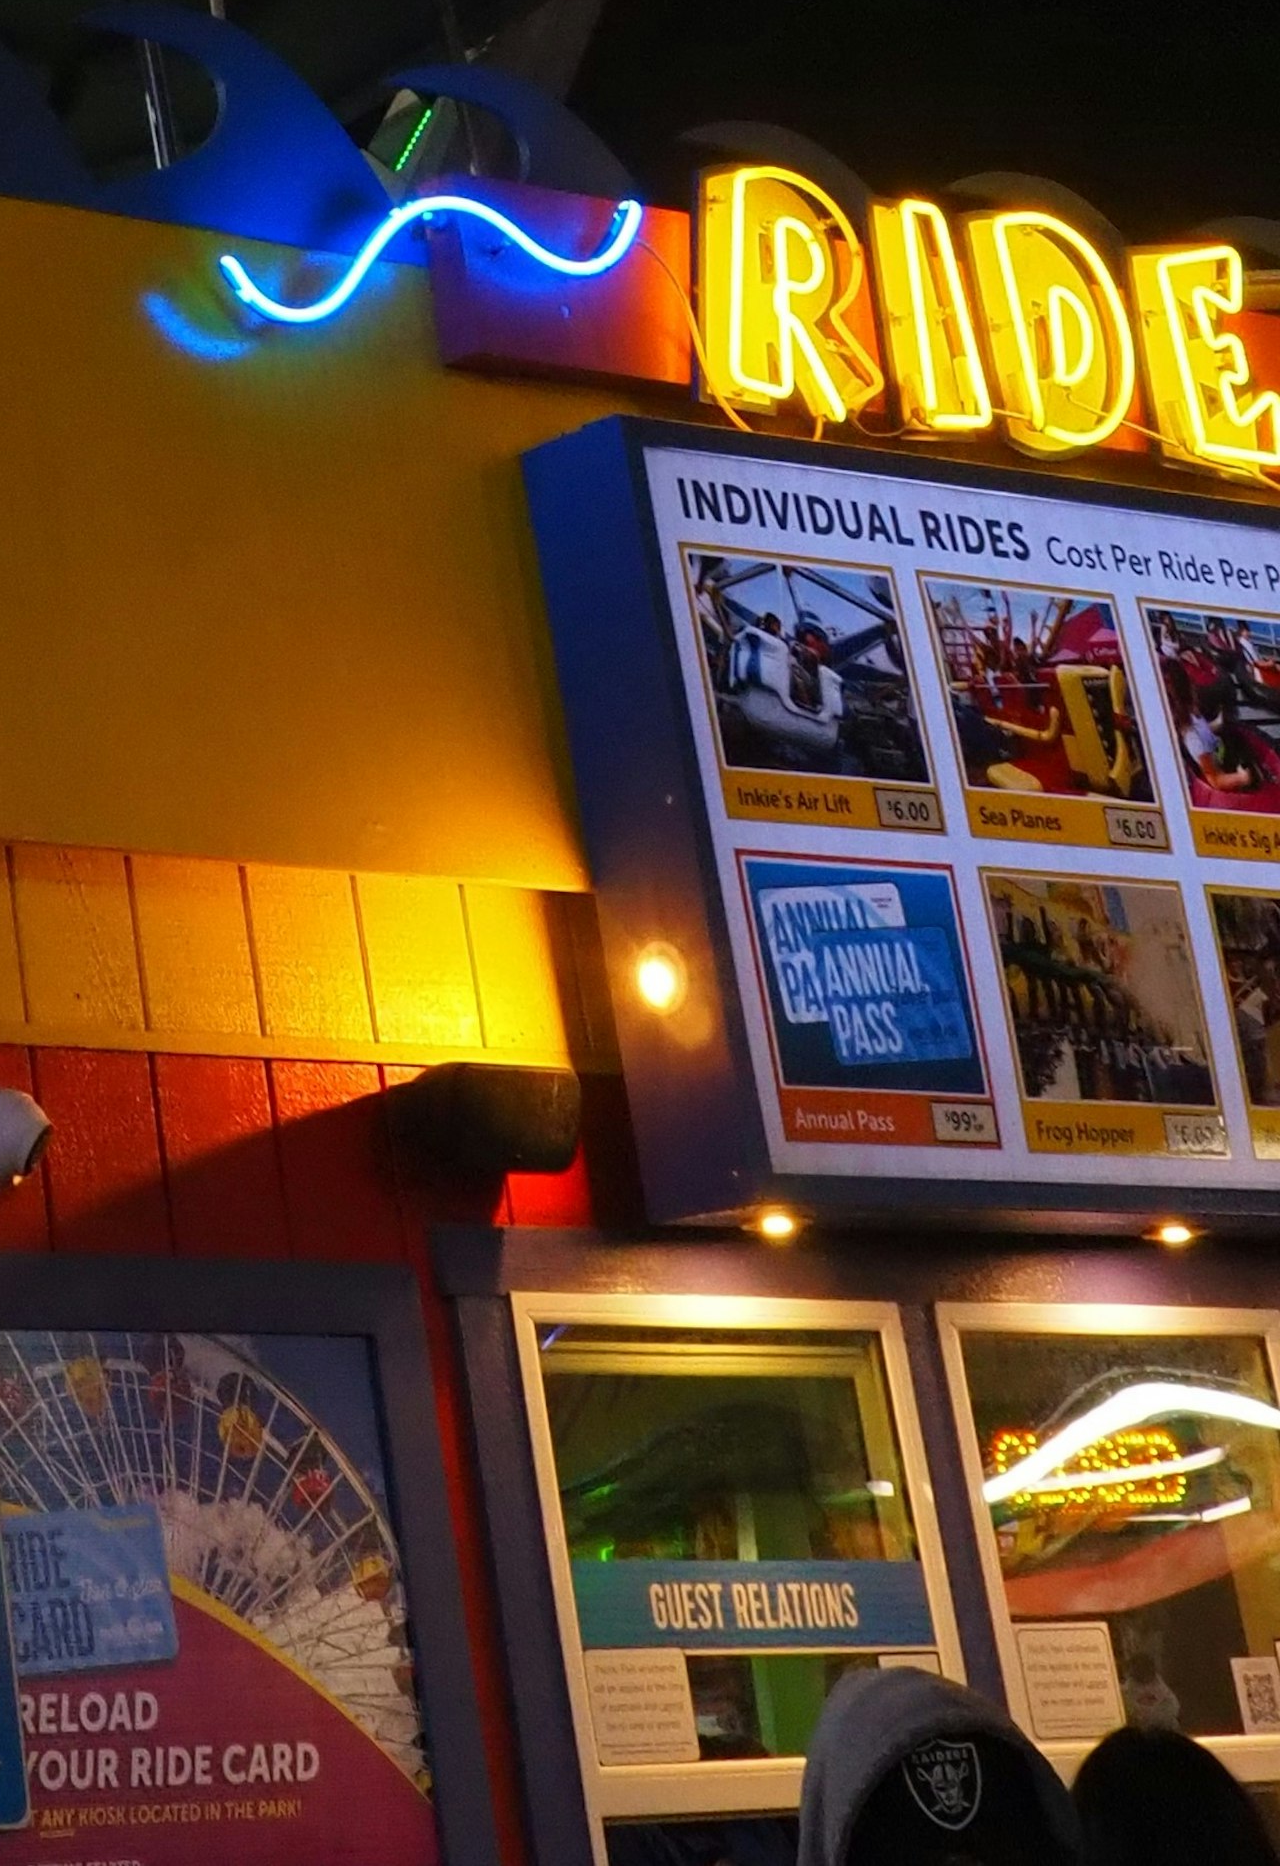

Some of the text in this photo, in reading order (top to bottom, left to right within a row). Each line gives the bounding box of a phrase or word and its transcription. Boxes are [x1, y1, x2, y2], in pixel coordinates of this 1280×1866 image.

[702, 165, 1280, 477] RIDE
[676, 476, 914, 548] INDIVIDUAL
[919, 510, 1032, 562] RIDES
[1045, 535, 1106, 571] Cost
[1111, 545, 1153, 578] Per
[1159, 550, 1214, 586] Ride
[1220, 558, 1260, 592] Per
[736, 786, 853, 815] Inkie's Air Lift
[887, 800, 930, 822] $6.00
[978, 805, 1062, 831] Sea Planes
[822, 941, 930, 997] ANNUAL
[832, 1001, 904, 1058] PASS
[795, 1107, 896, 1133] Annual Pass
[1035, 1118, 1135, 1147] Frog Hopper
[648, 1580, 860, 1631] GUEST RELATIONS
[20, 1691, 159, 1734] RELOAD
[130, 1745, 214, 1787] RIDE
[221, 1742, 321, 1783] CARD
[41, 1807, 75, 1828] ANY
[78, 1805, 126, 1827] KIOSK
[128, 1802, 202, 1826] LOCATED
[204, 1802, 221, 1821] IN
[224, 1801, 257, 1820] THE
[258, 1798, 302, 1819] PARK!
